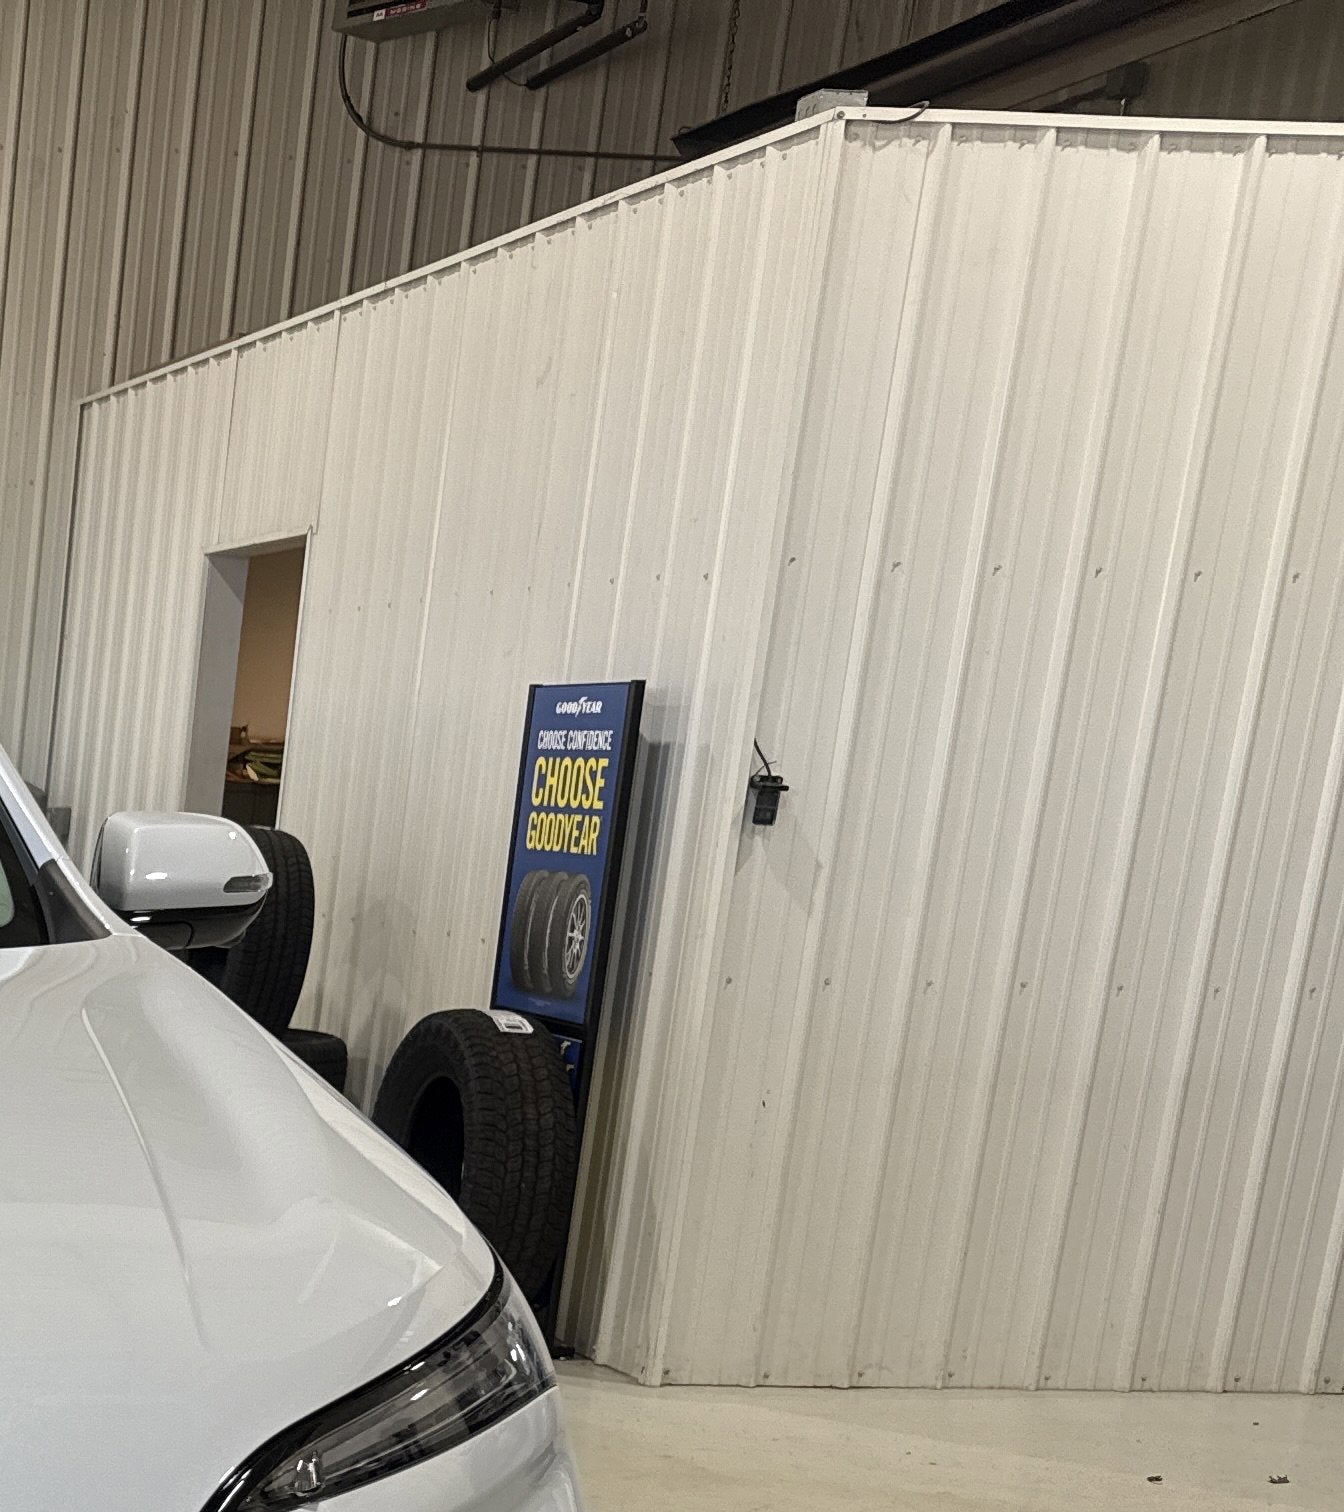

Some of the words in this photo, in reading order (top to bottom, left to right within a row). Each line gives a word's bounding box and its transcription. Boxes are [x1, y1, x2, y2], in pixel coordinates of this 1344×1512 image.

[555, 697, 603, 717] GOODYEAR
[537, 730, 567, 751] CHOOSE
[566, 730, 613, 751] CONFIDENCE
[531, 756, 610, 810] CHOOSE
[526, 811, 601, 856] GOODYEAR
